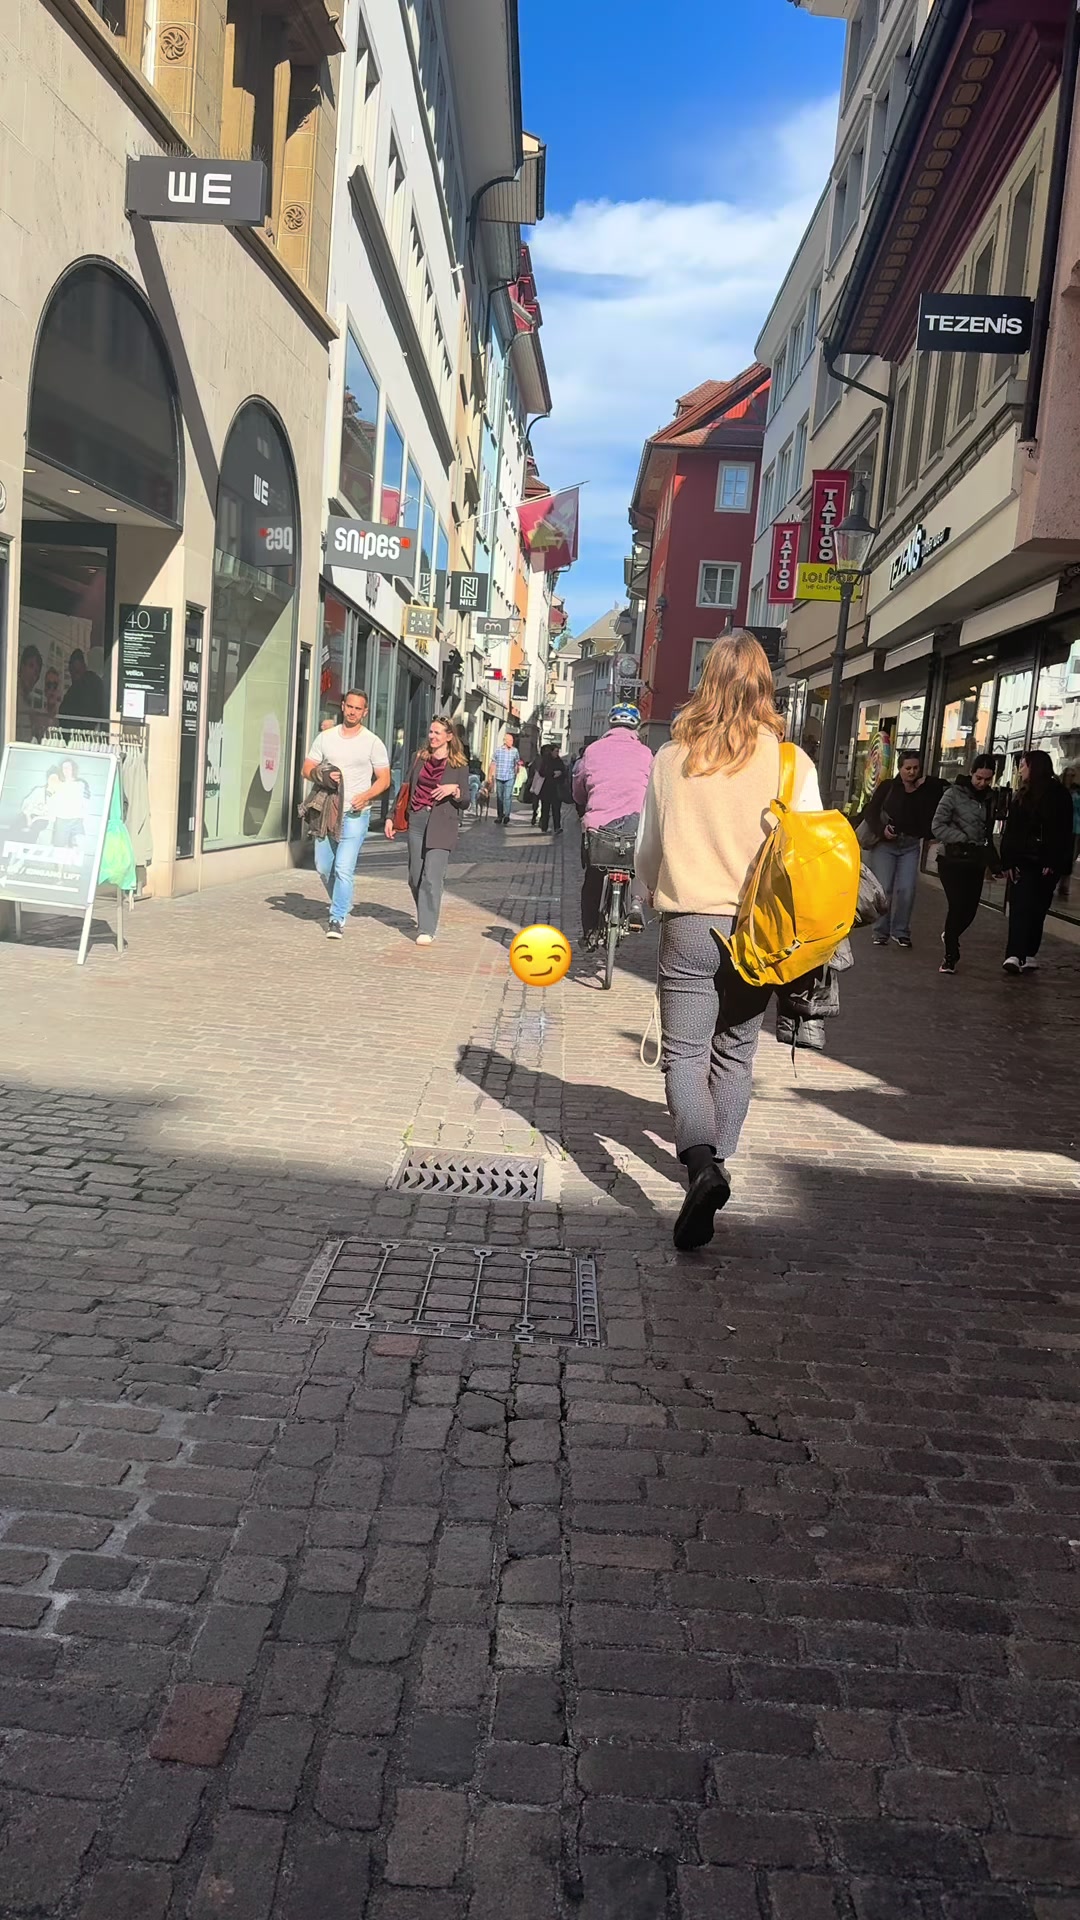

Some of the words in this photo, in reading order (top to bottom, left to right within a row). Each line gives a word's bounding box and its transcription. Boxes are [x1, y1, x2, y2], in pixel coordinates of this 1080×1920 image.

[168, 171, 231, 205] WE
[253, 473, 269, 506] WE
[819, 488, 838, 561] TATTOO
[334, 526, 400, 561] snipes
[777, 530, 794, 590] TATTOO
[459, 598, 478, 607] NILE
[125, 610, 150, 630] 40
